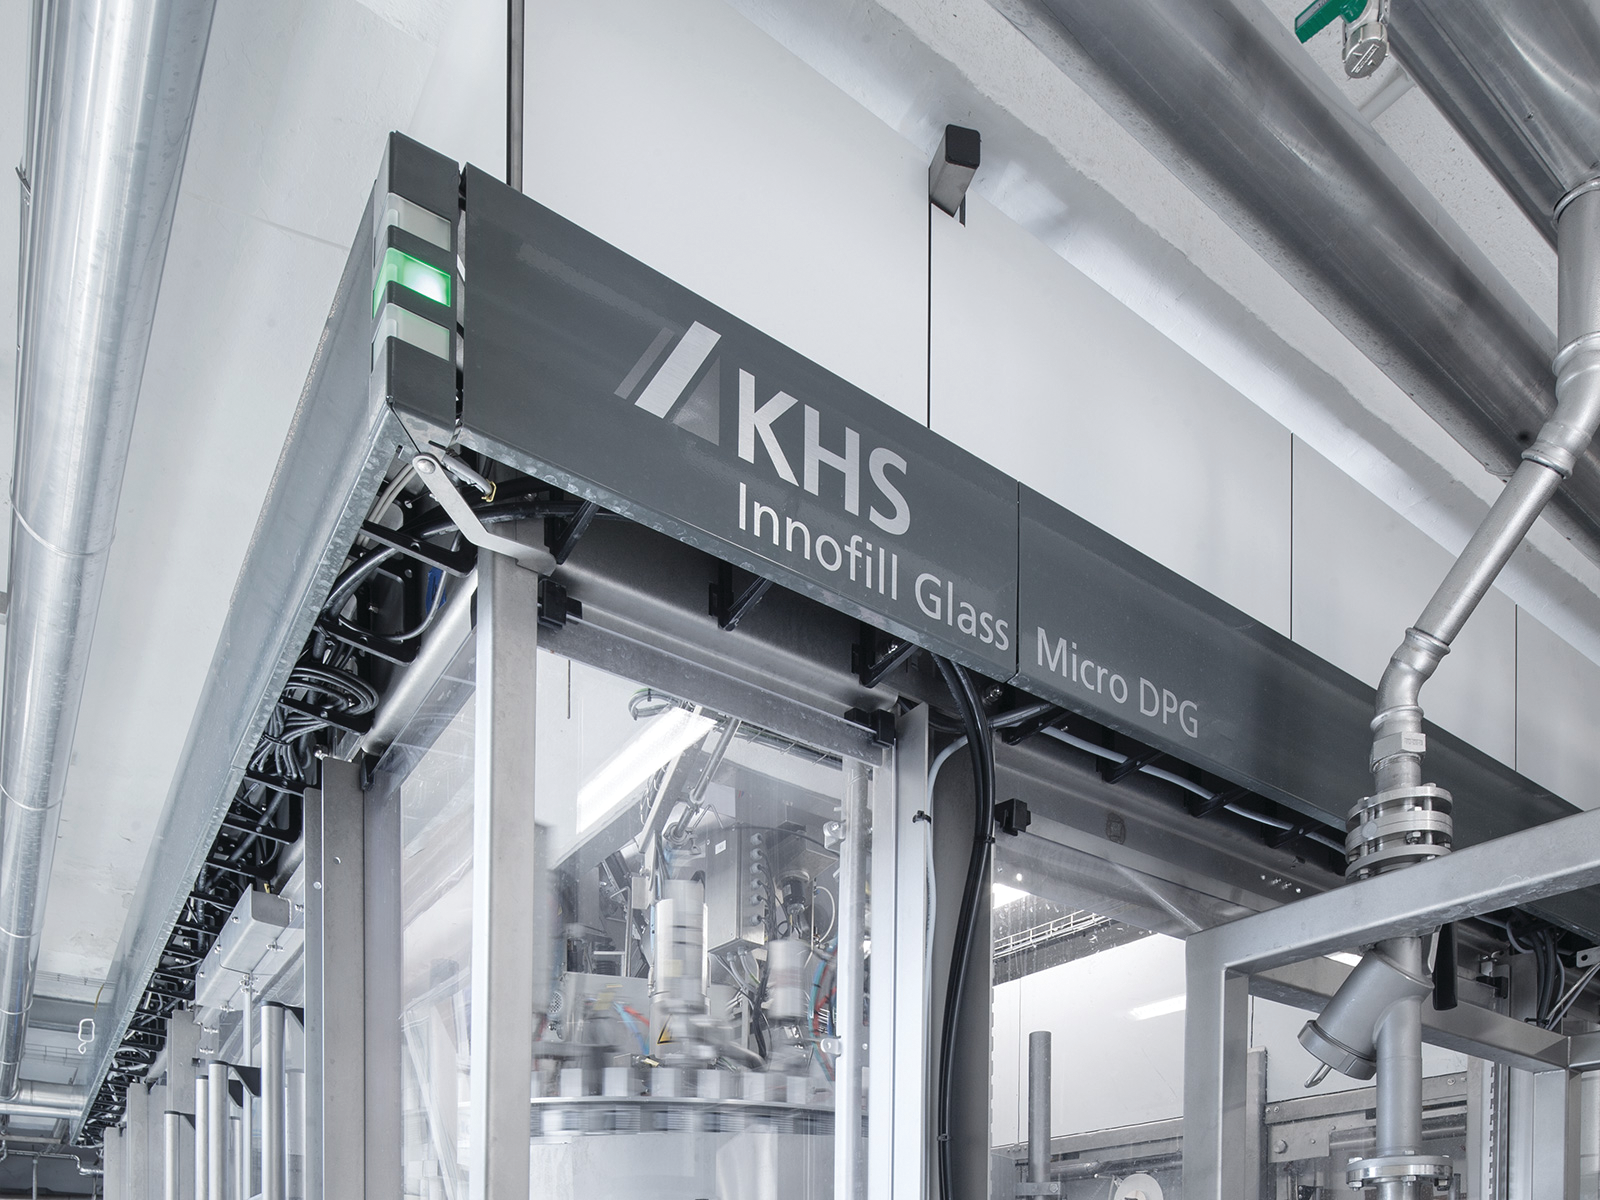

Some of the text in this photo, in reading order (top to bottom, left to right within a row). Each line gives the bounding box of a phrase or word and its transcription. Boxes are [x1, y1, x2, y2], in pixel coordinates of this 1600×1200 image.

[738, 368, 911, 535] KHS
[738, 483, 1199, 738] Innofill Glass Micro DPG
